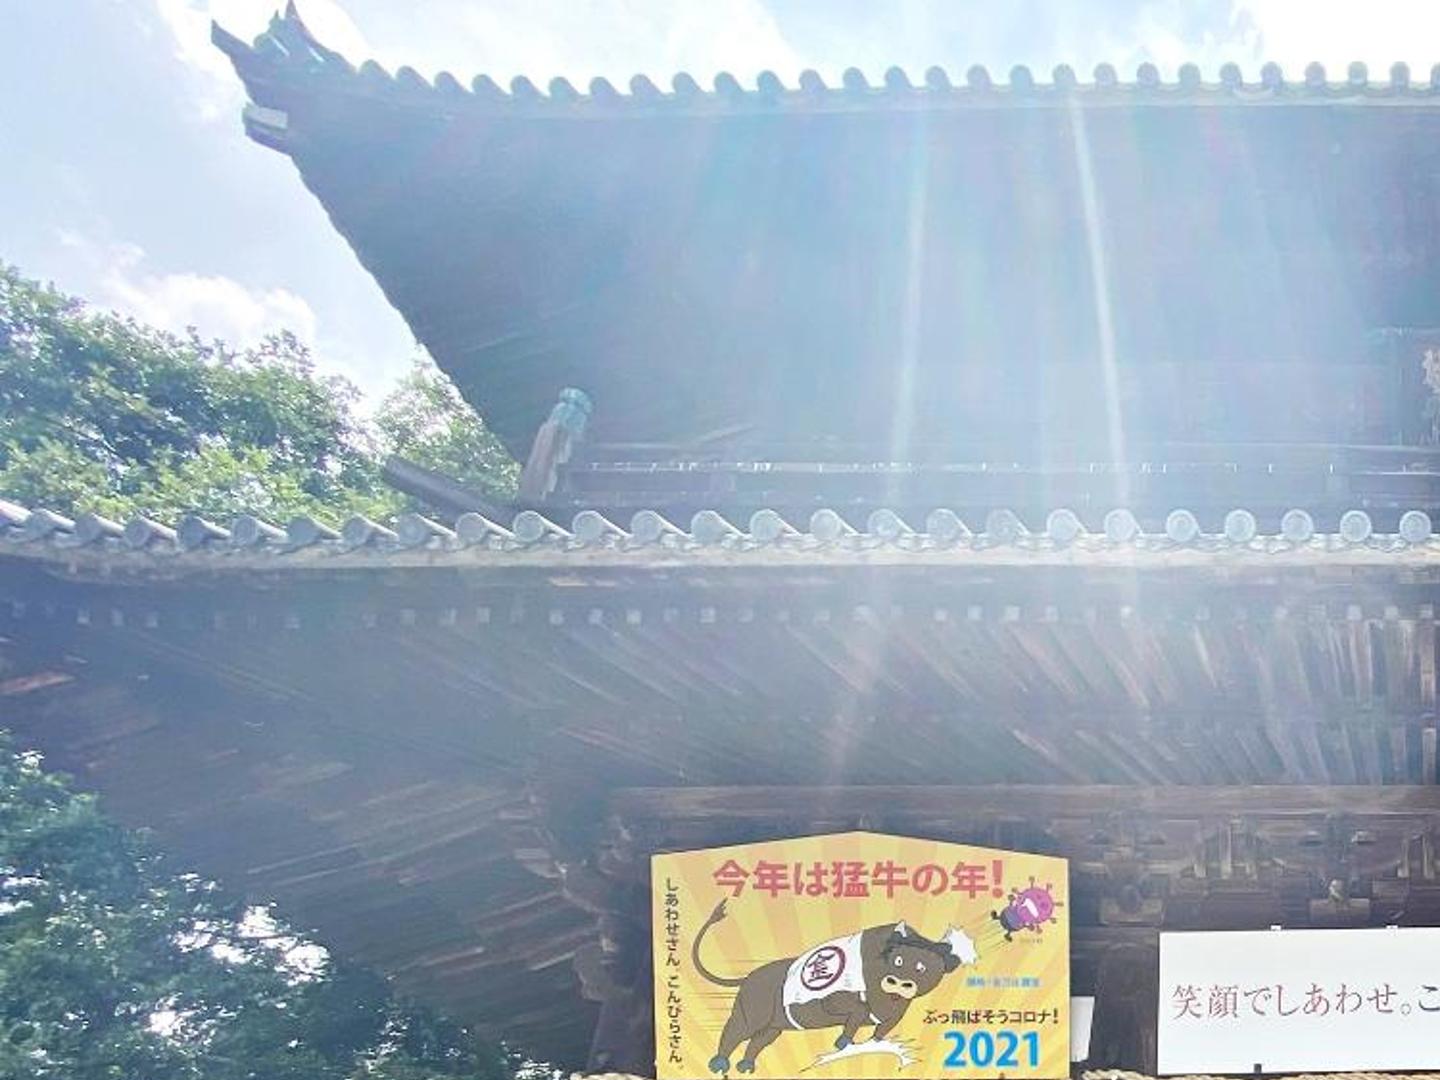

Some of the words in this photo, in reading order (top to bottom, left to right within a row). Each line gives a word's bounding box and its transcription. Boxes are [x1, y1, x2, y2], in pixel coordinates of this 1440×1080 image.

[712, 858, 1005, 900] 今年は猛牛の年!
[943, 1030, 1040, 1067] 2021
